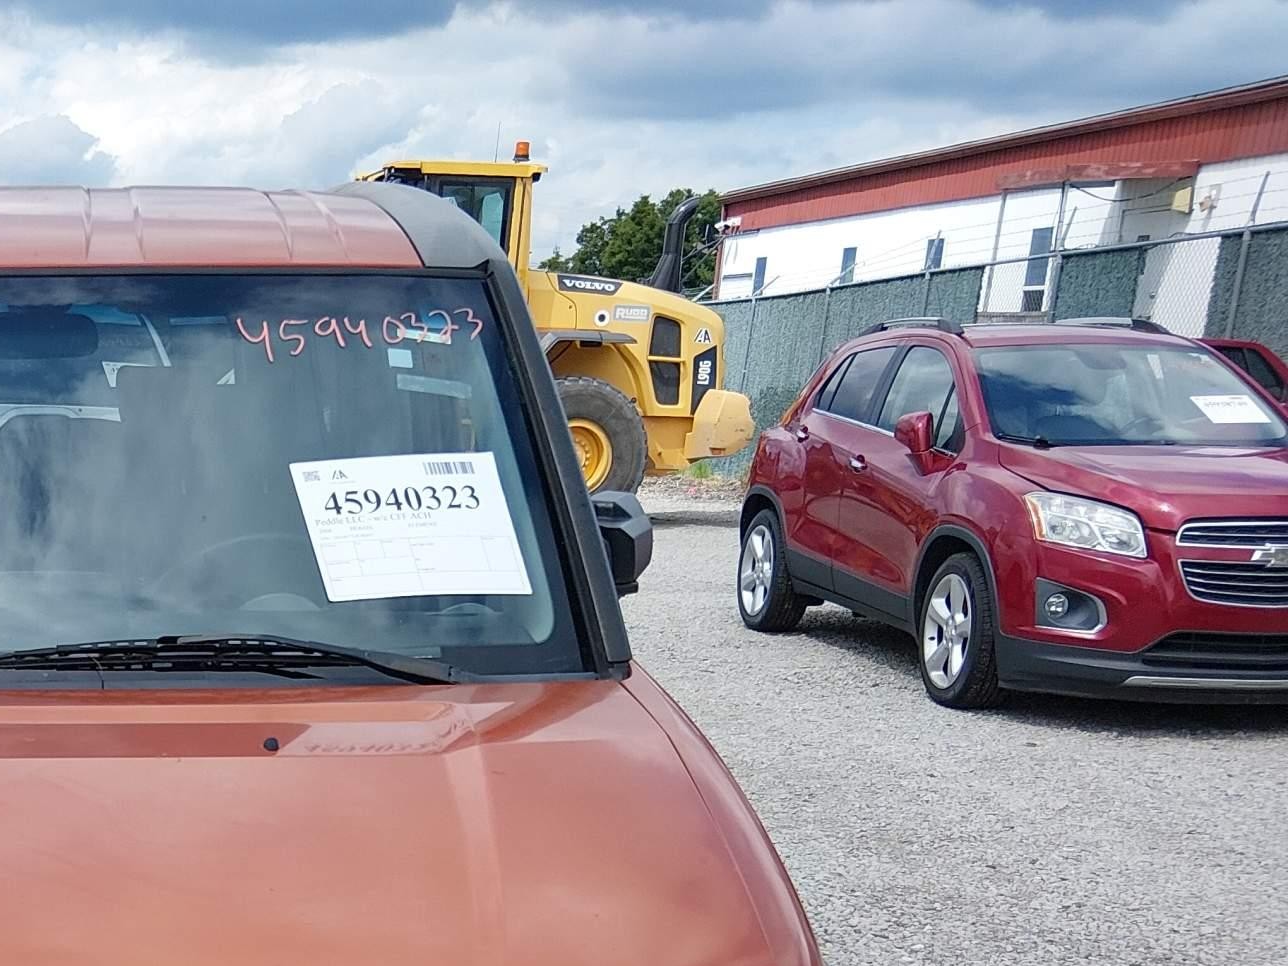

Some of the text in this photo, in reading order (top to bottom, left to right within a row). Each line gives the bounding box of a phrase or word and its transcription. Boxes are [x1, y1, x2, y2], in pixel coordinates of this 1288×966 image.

[562, 279, 616, 292] VOLVO
[236, 308, 484, 363] 45940323
[696, 360, 712, 385] L90G
[324, 485, 480, 515] 45940323
